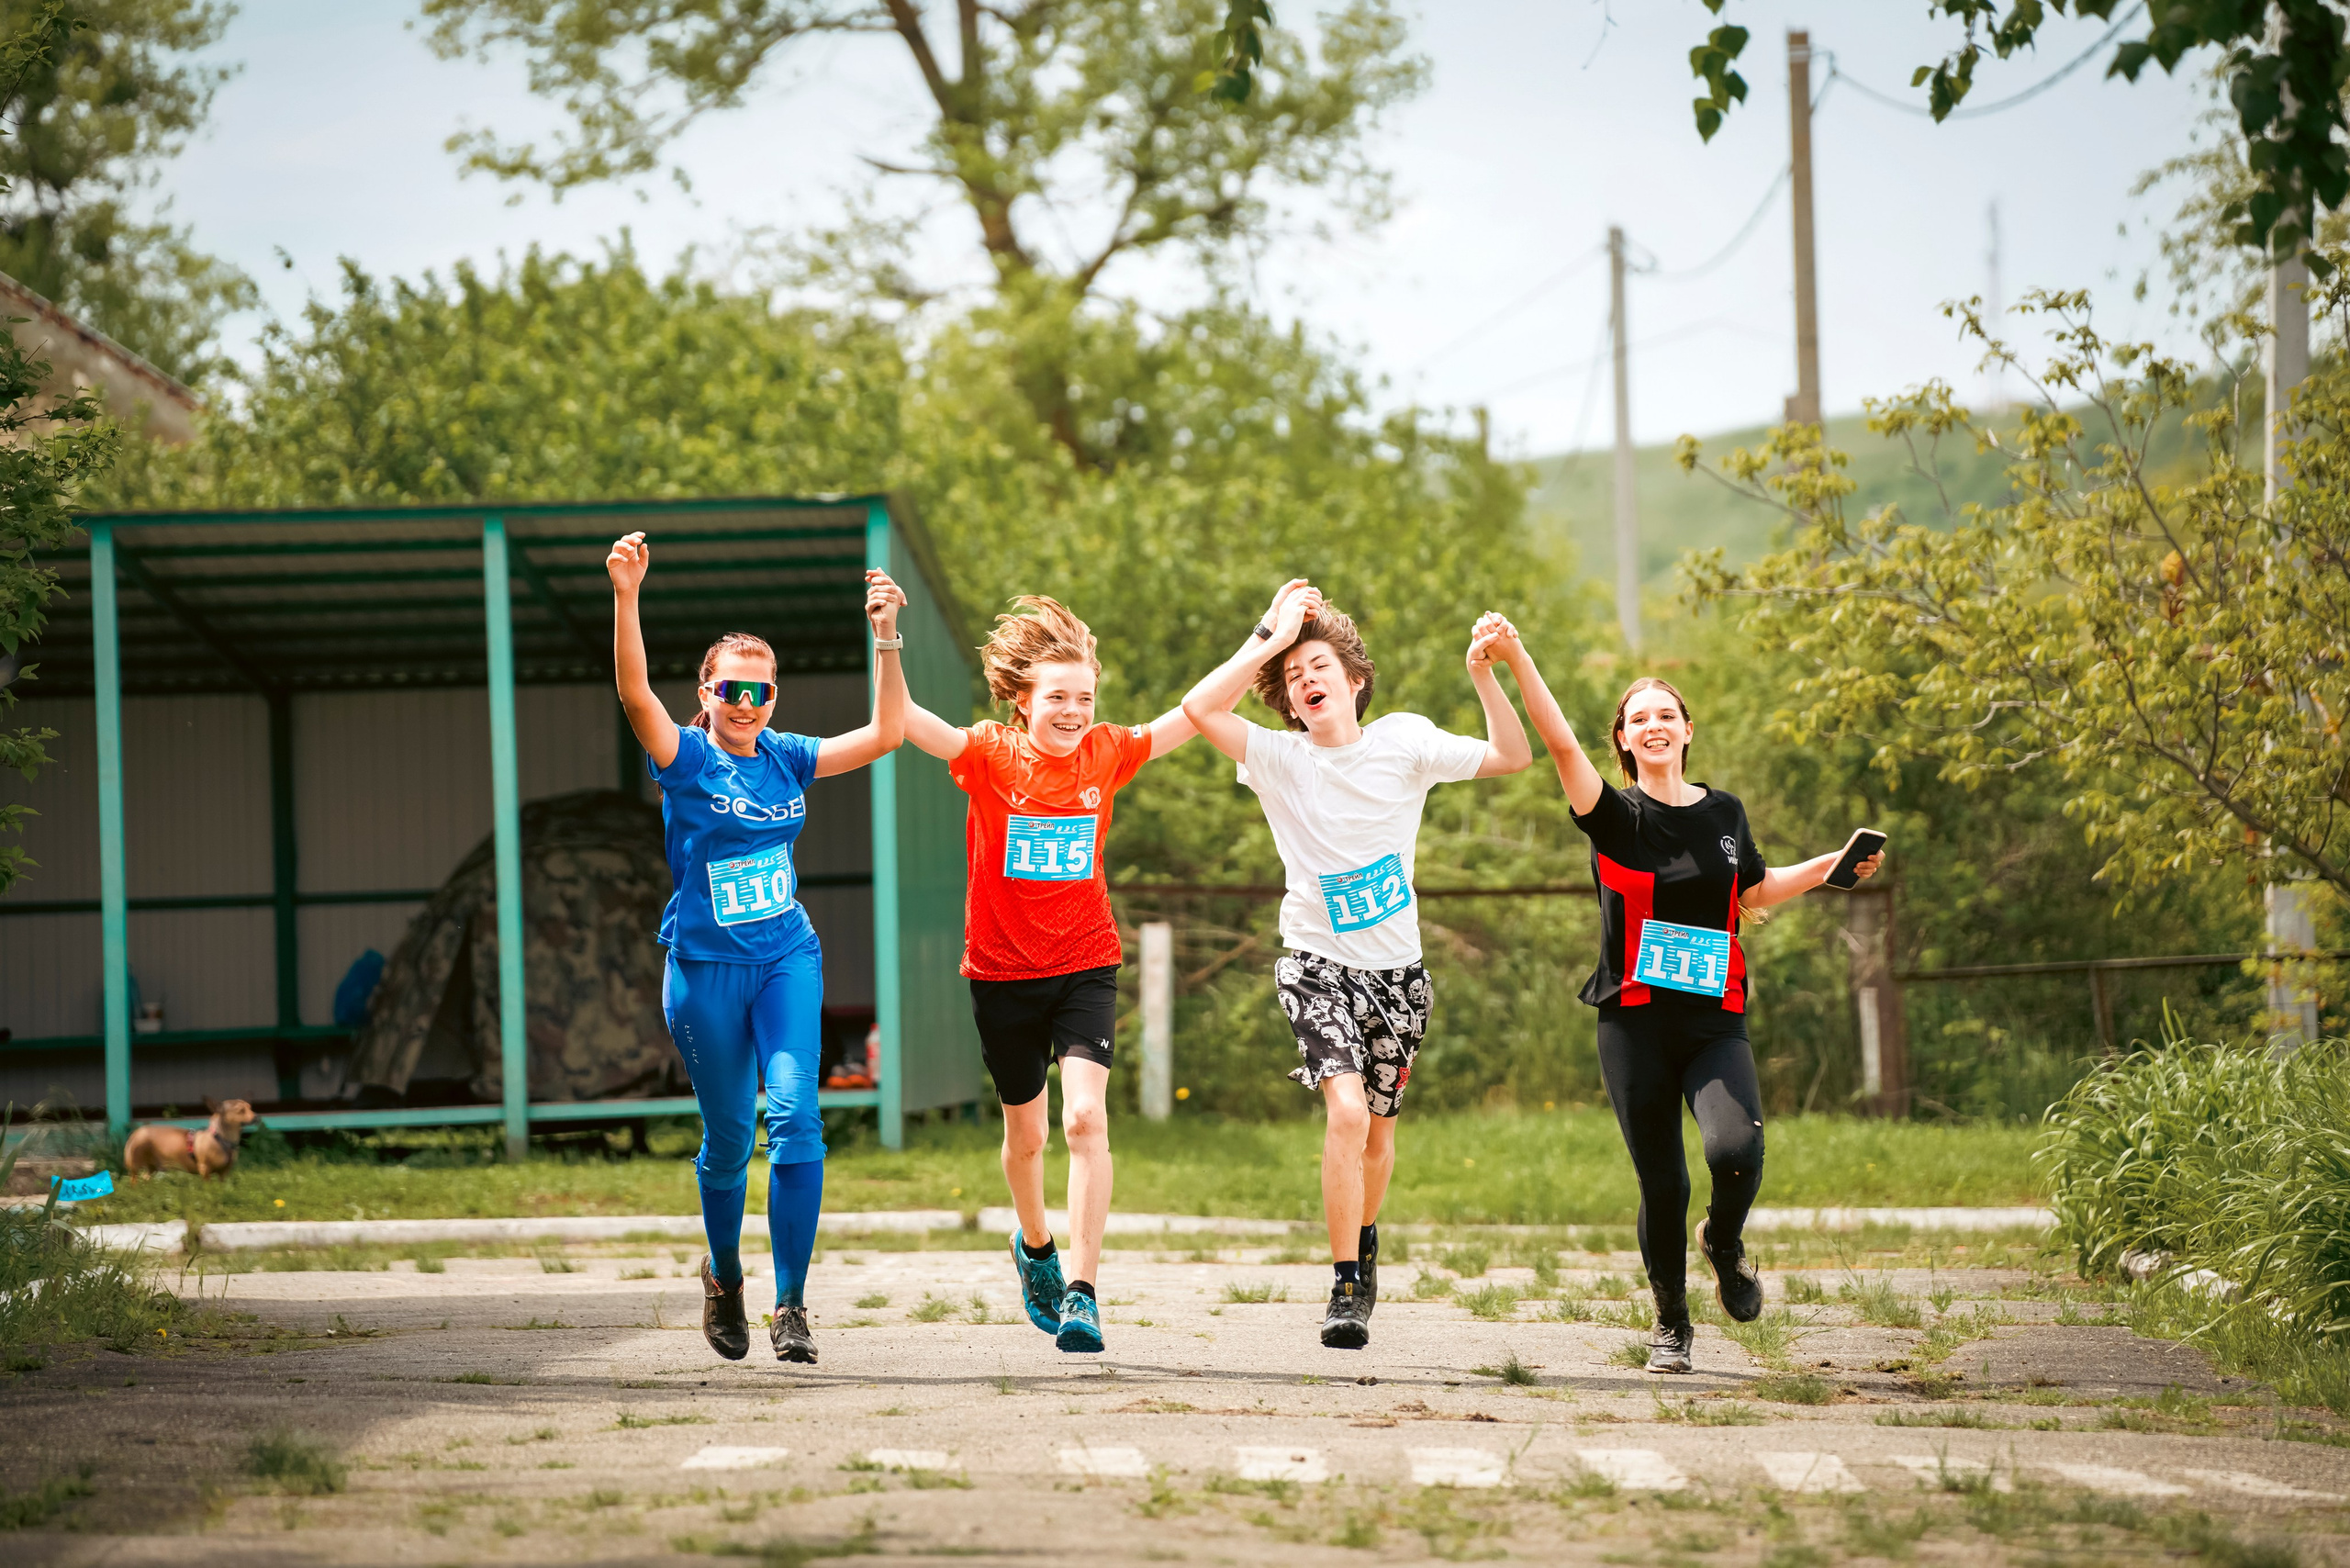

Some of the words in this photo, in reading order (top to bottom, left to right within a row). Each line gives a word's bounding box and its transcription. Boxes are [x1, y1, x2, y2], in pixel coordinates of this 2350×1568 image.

[1013, 840, 1088, 873] 115
[720, 868, 788, 916] 110
[1332, 874, 1406, 925] 112
[1643, 945, 1720, 989] 111
